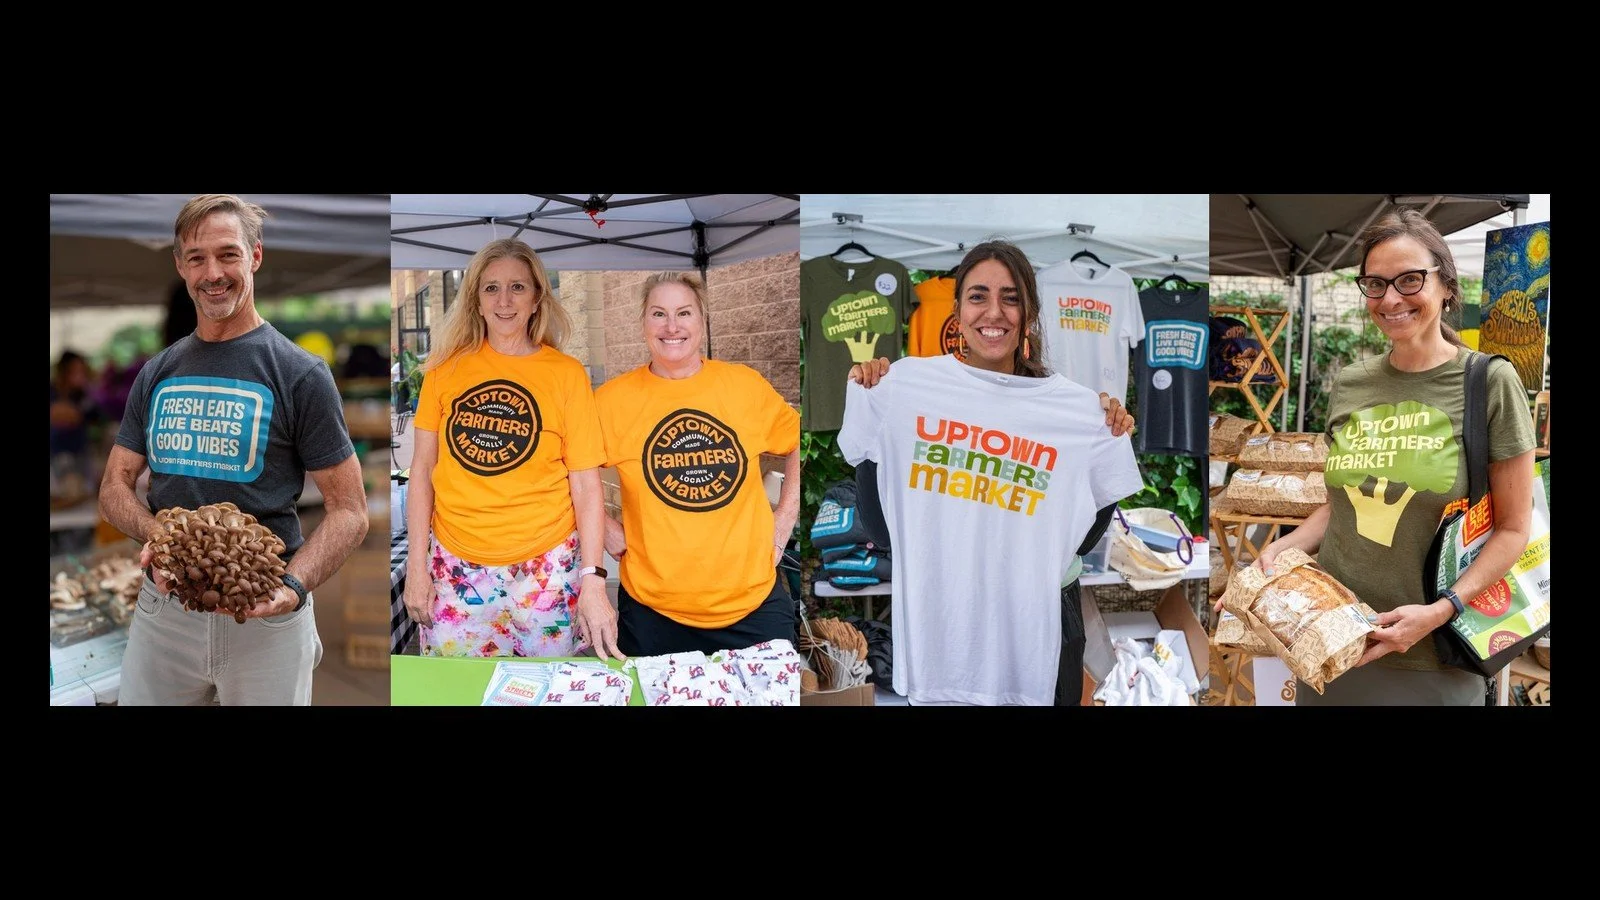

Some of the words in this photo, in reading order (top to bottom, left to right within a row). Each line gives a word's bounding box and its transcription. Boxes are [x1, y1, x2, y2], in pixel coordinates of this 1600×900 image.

[1156, 331, 1180, 340] FRESH
[1155, 347, 1176, 356] GOOD
[161, 397, 205, 416] FRESH
[206, 399, 246, 420] EATS
[465, 390, 528, 416] UPTOWN
[477, 403, 516, 416] COMMUNITY
[488, 408, 504, 416] MADE
[158, 416, 187, 430] LIVE
[190, 417, 242, 436] BEATS
[478, 432, 500, 441] GROWN
[656, 419, 725, 448] UPTOWN
[156, 432, 193, 452] GOOD
[196, 435, 240, 457] VIBES
[471, 435, 504, 448] LOCALLY
[671, 433, 713, 449] COMMUNITY
[684, 441, 701, 449] MADE
[679, 472, 714, 484] LOCALLY
